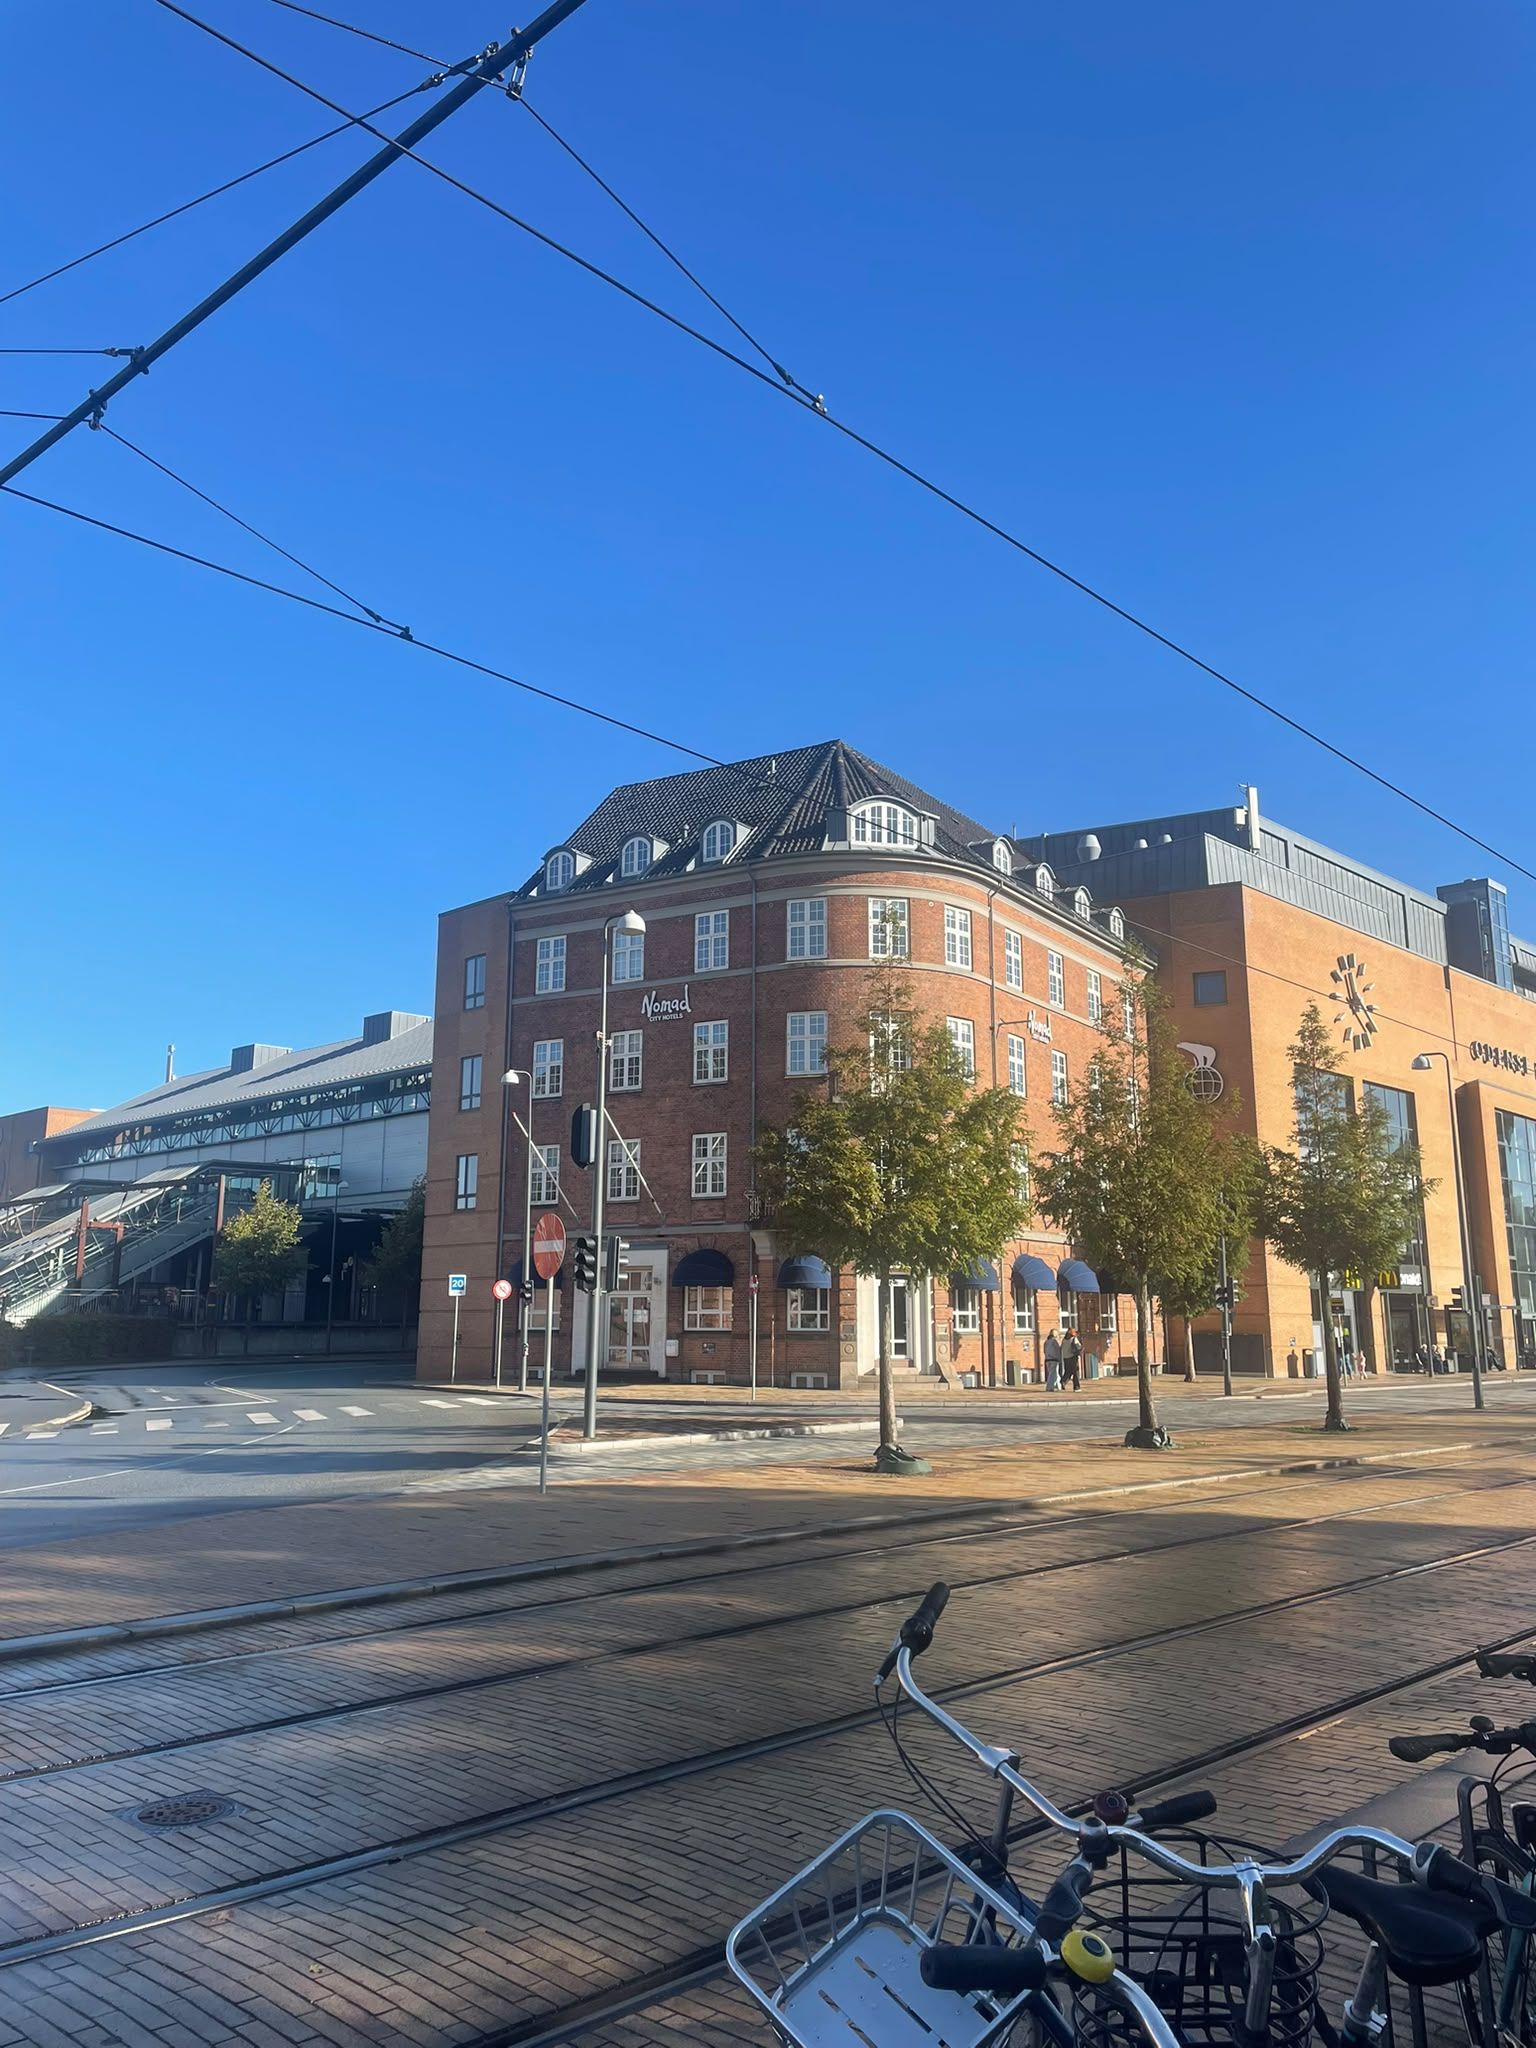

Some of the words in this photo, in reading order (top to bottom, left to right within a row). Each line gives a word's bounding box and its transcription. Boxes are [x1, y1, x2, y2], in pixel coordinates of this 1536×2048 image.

[641, 983, 692, 1018] Nomad
[662, 1012, 684, 1021] HOTELS
[452, 1279, 464, 1288] 20
